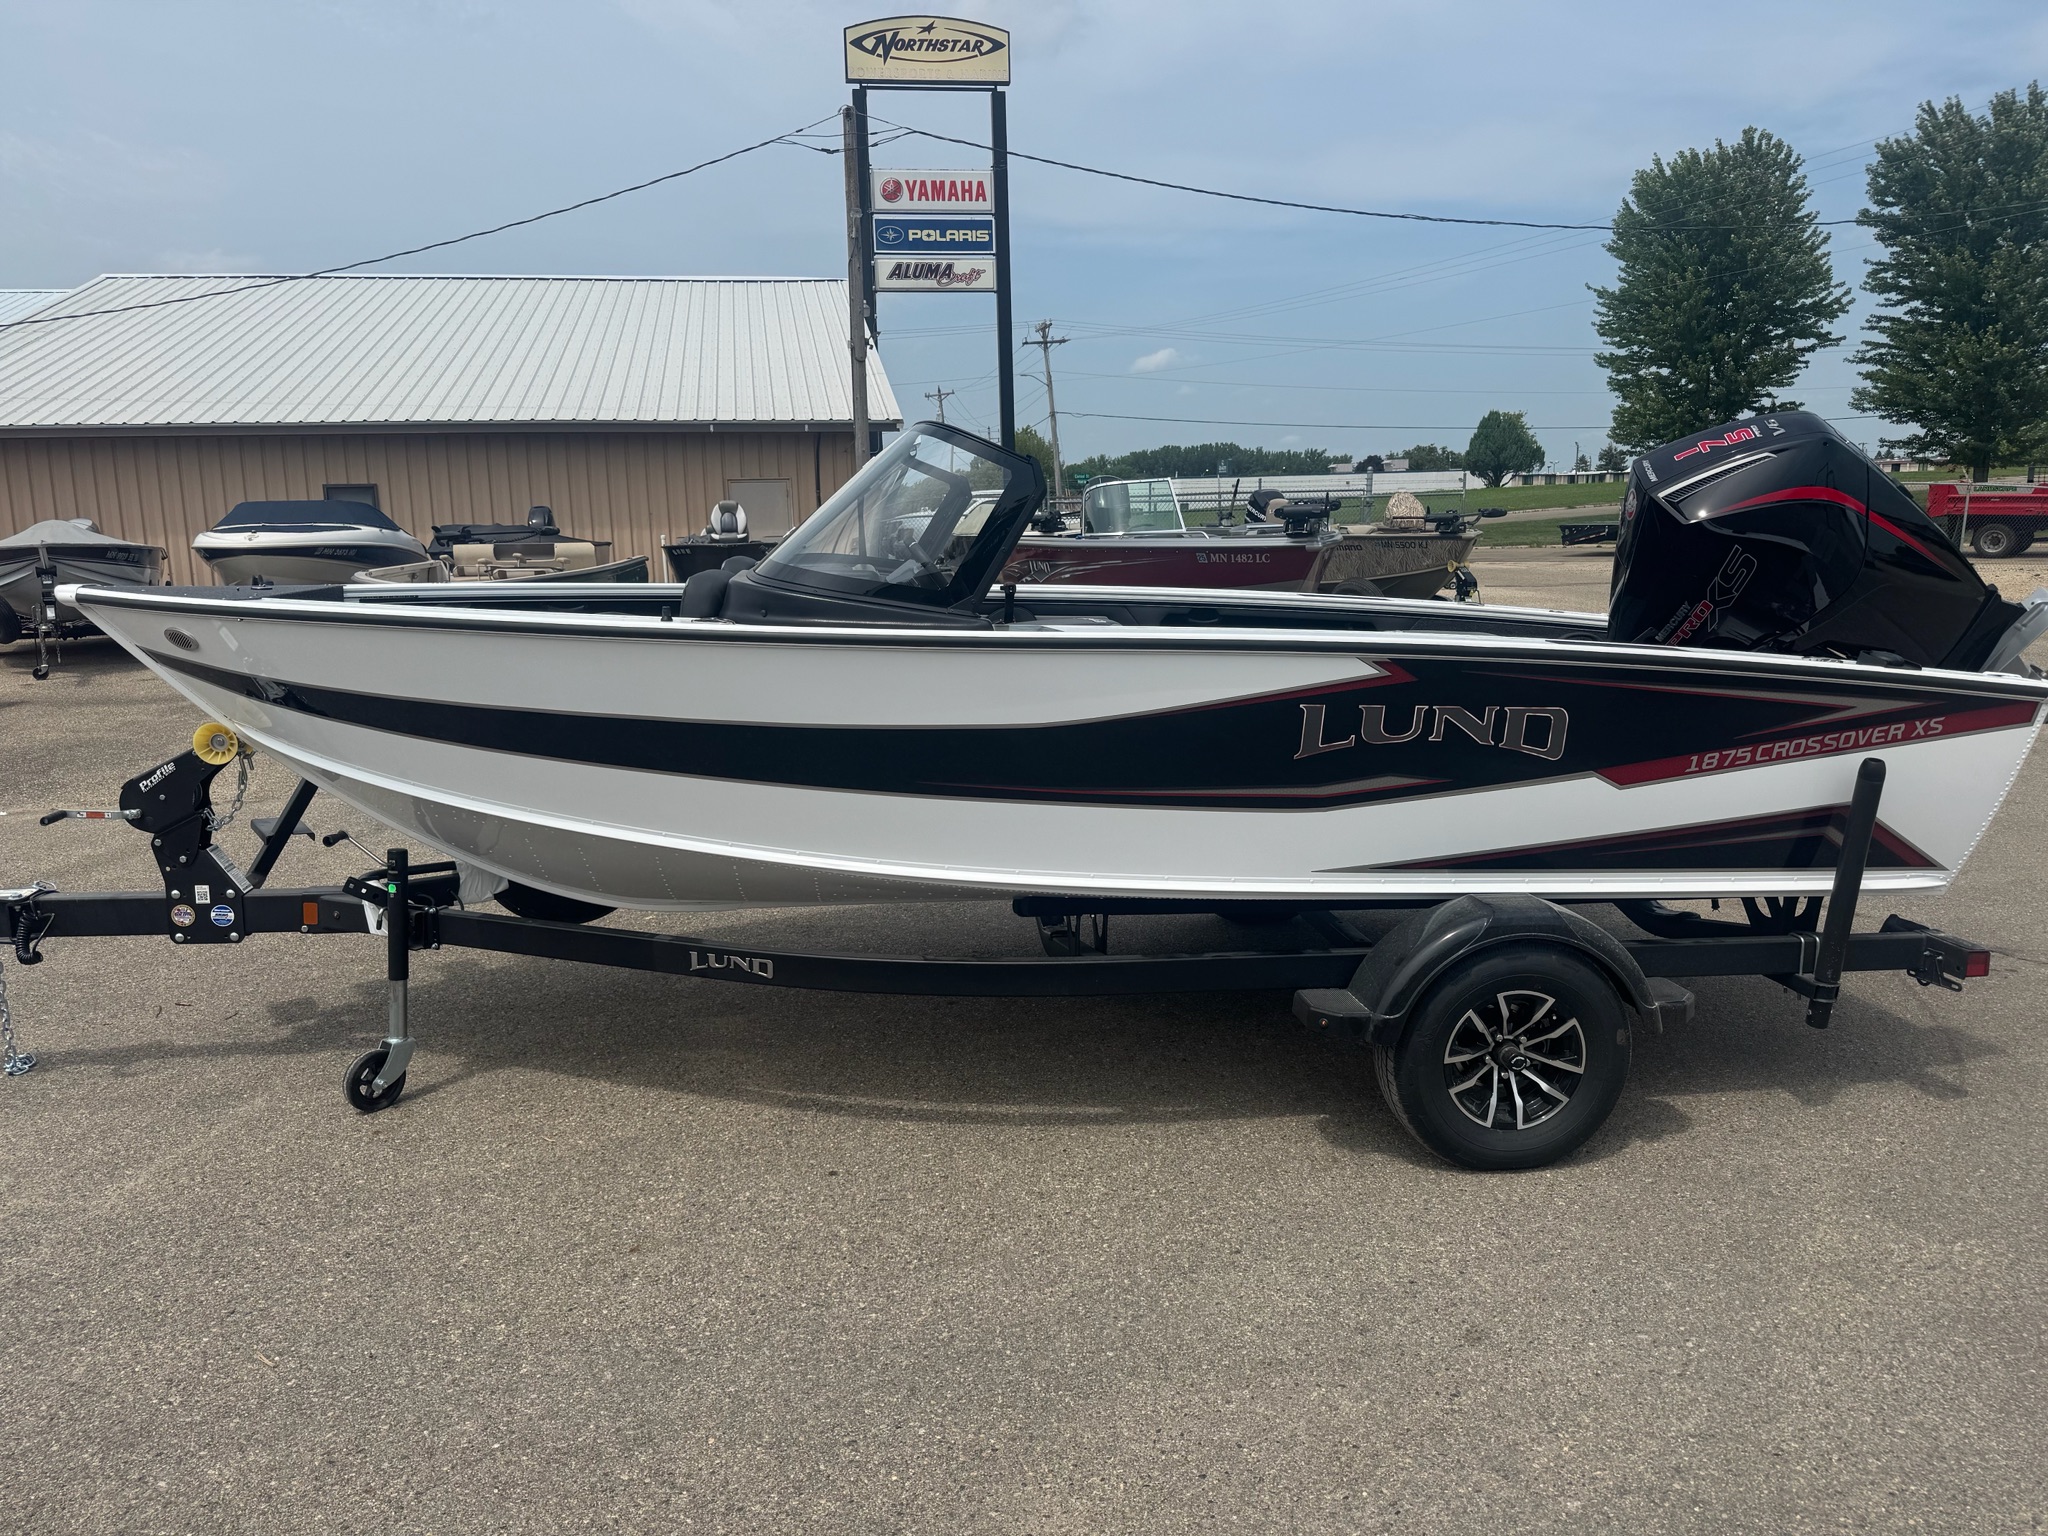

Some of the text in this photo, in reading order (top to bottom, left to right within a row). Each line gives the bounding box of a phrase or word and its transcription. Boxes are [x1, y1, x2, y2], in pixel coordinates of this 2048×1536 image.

[873, 31, 985, 66] NORTHSTAR
[905, 179, 987, 202] YAMAHA
[908, 229, 990, 242] POLARIS
[1764, 419, 1786, 436] V6
[1674, 427, 1754, 461] 175
[1642, 460, 1658, 482] MERCURY
[1210, 553, 1228, 563] MN
[1231, 553, 1253, 563] 1482
[1256, 553, 1271, 563] LC
[1395, 541, 1416, 549] 5500
[1418, 541, 1428, 549] KJ
[1707, 544, 1757, 632] XS
[1655, 601, 1691, 642] MERCURY
[1665, 600, 1713, 647] PRO
[1294, 704, 1568, 760] LUND
[1685, 716, 1945, 772] 1875 CROSSOVER XS
[139, 761, 175, 791] Profile
[689, 951, 773, 979] LUND
